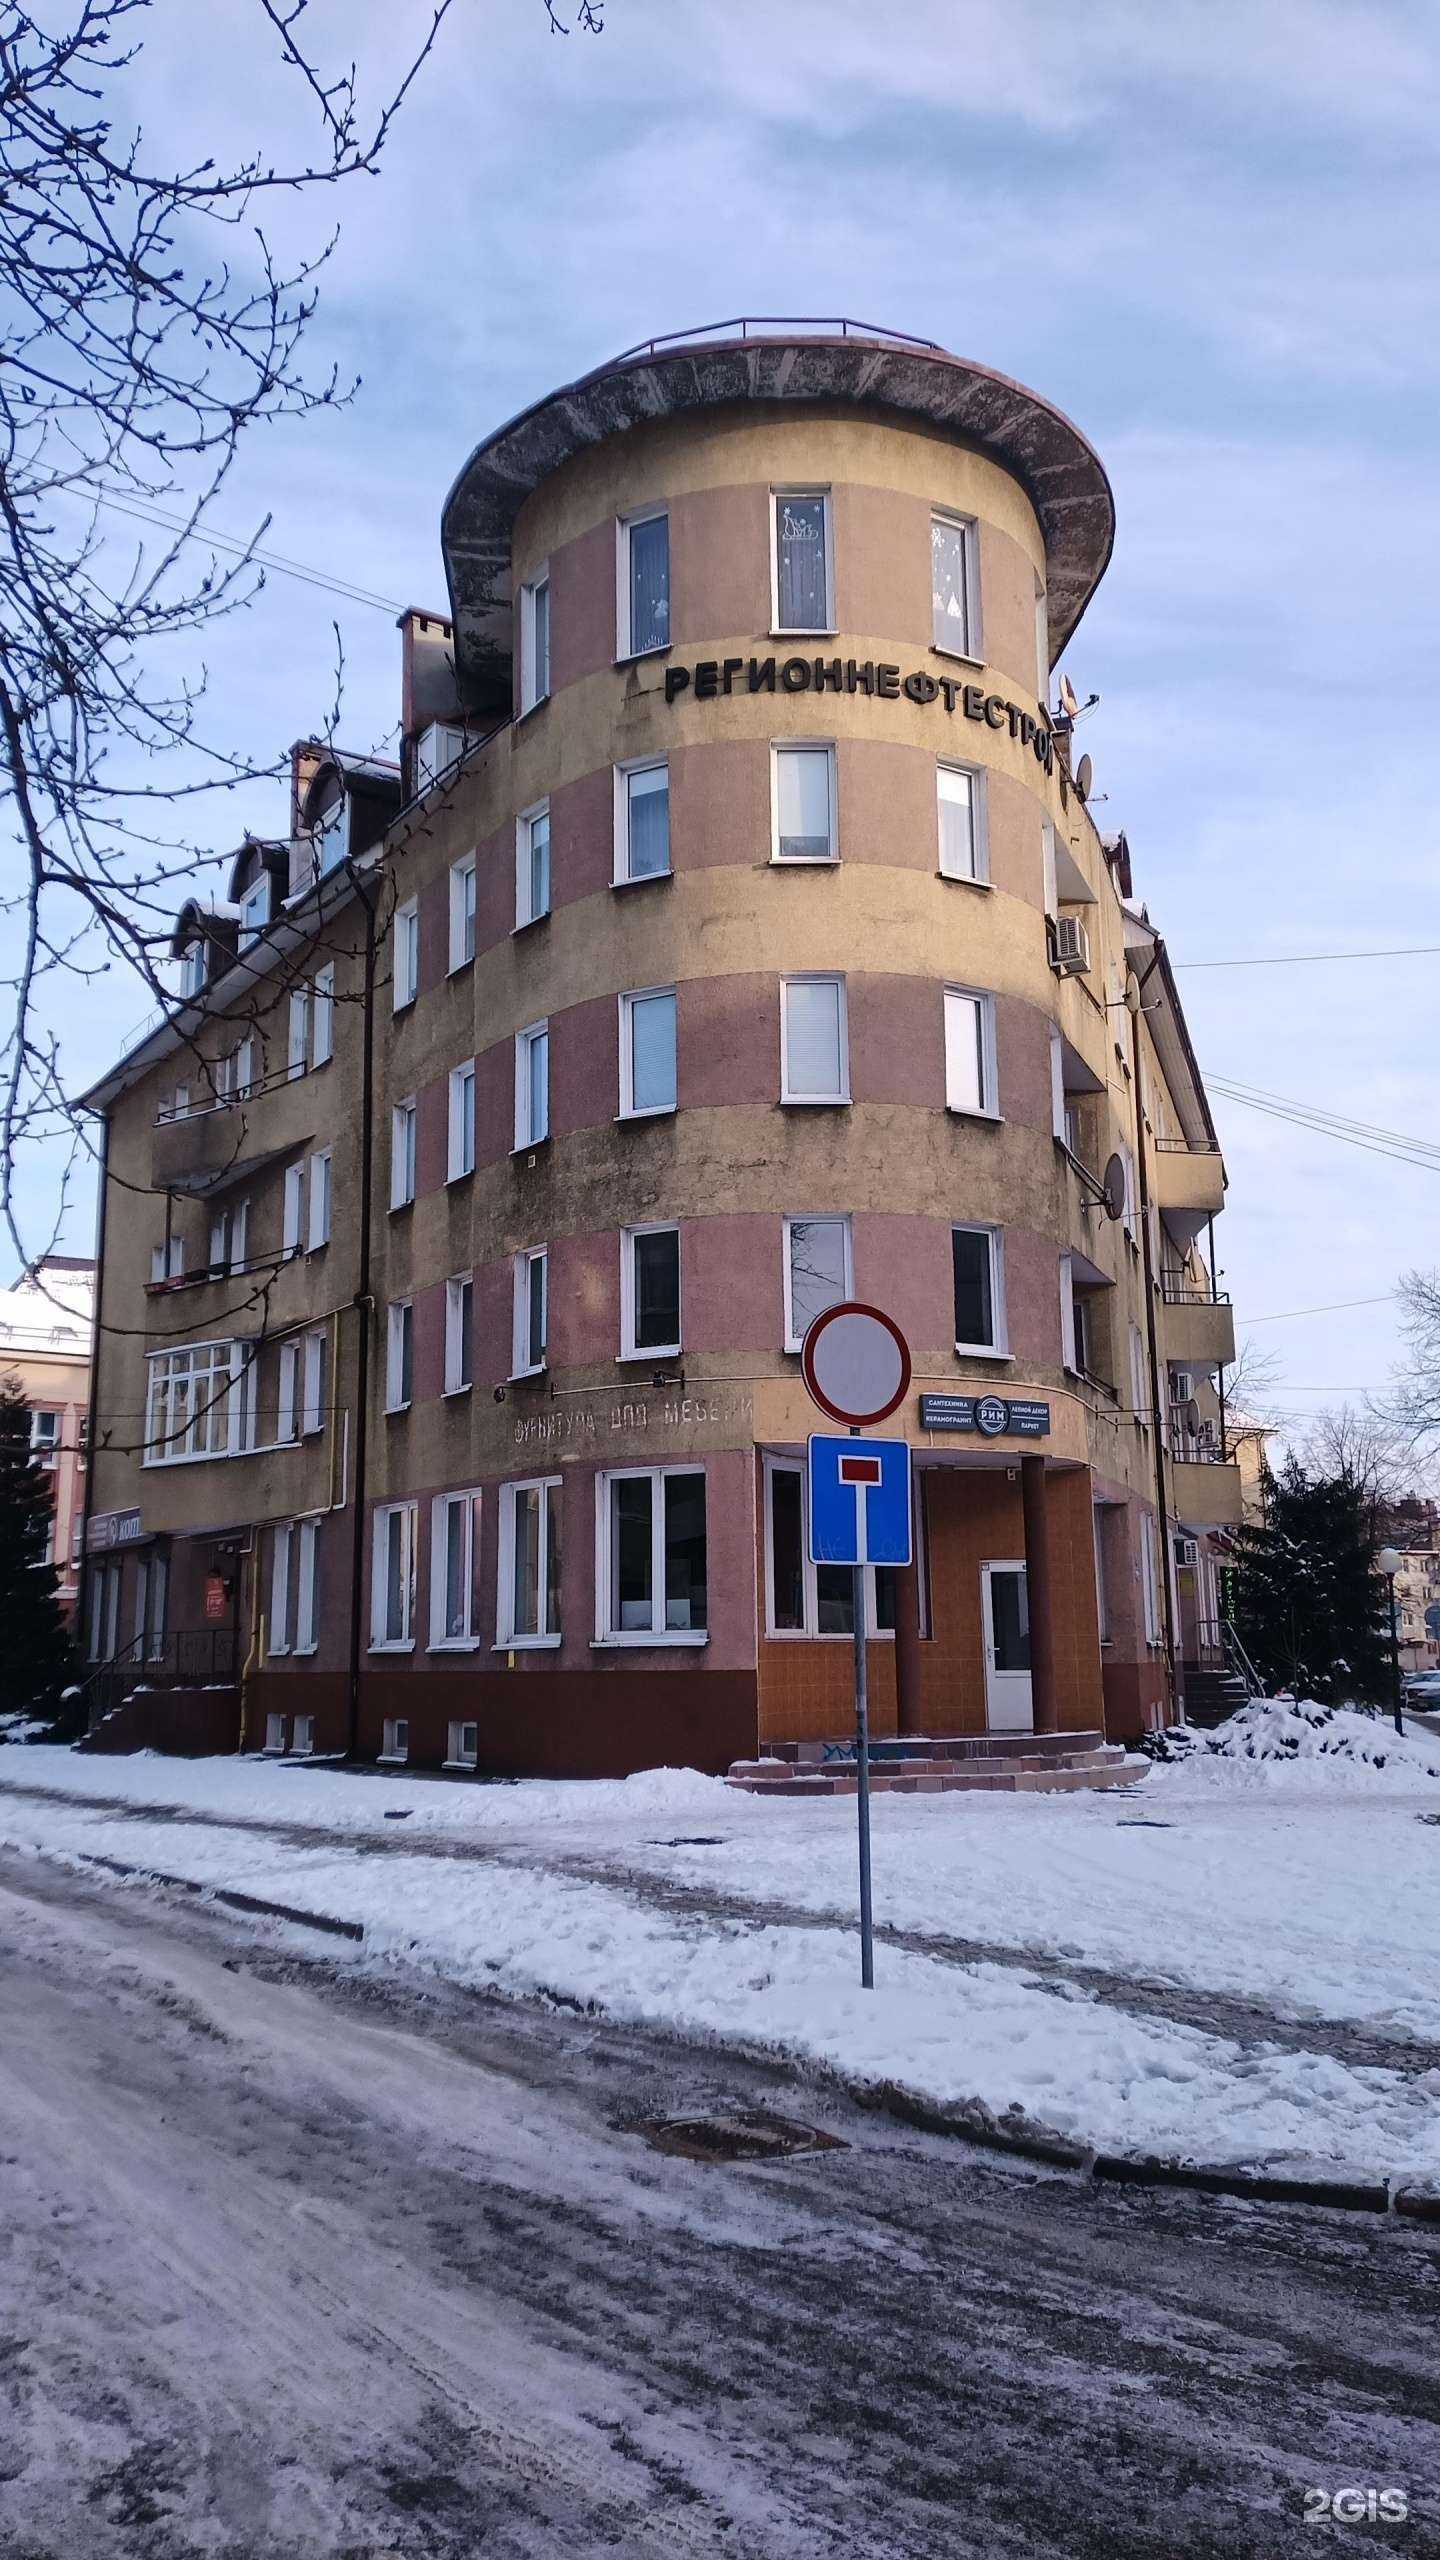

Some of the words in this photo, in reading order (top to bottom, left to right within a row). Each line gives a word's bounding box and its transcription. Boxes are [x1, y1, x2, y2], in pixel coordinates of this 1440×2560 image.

[929, 1400, 969, 1408] САНТЕХНИКА
[664, 1398, 753, 1426] МЕБЕИ
[1011, 1405, 1031, 1413] ЛЕПНОЙ
[1031, 1407, 1048, 1415] ДЕКОР
[925, 1415, 973, 1424] КЕРАМОГРАНИТ
[981, 1409, 1005, 1421] РИМ
[1021, 1421, 1040, 1430] ПАРКЕТ
